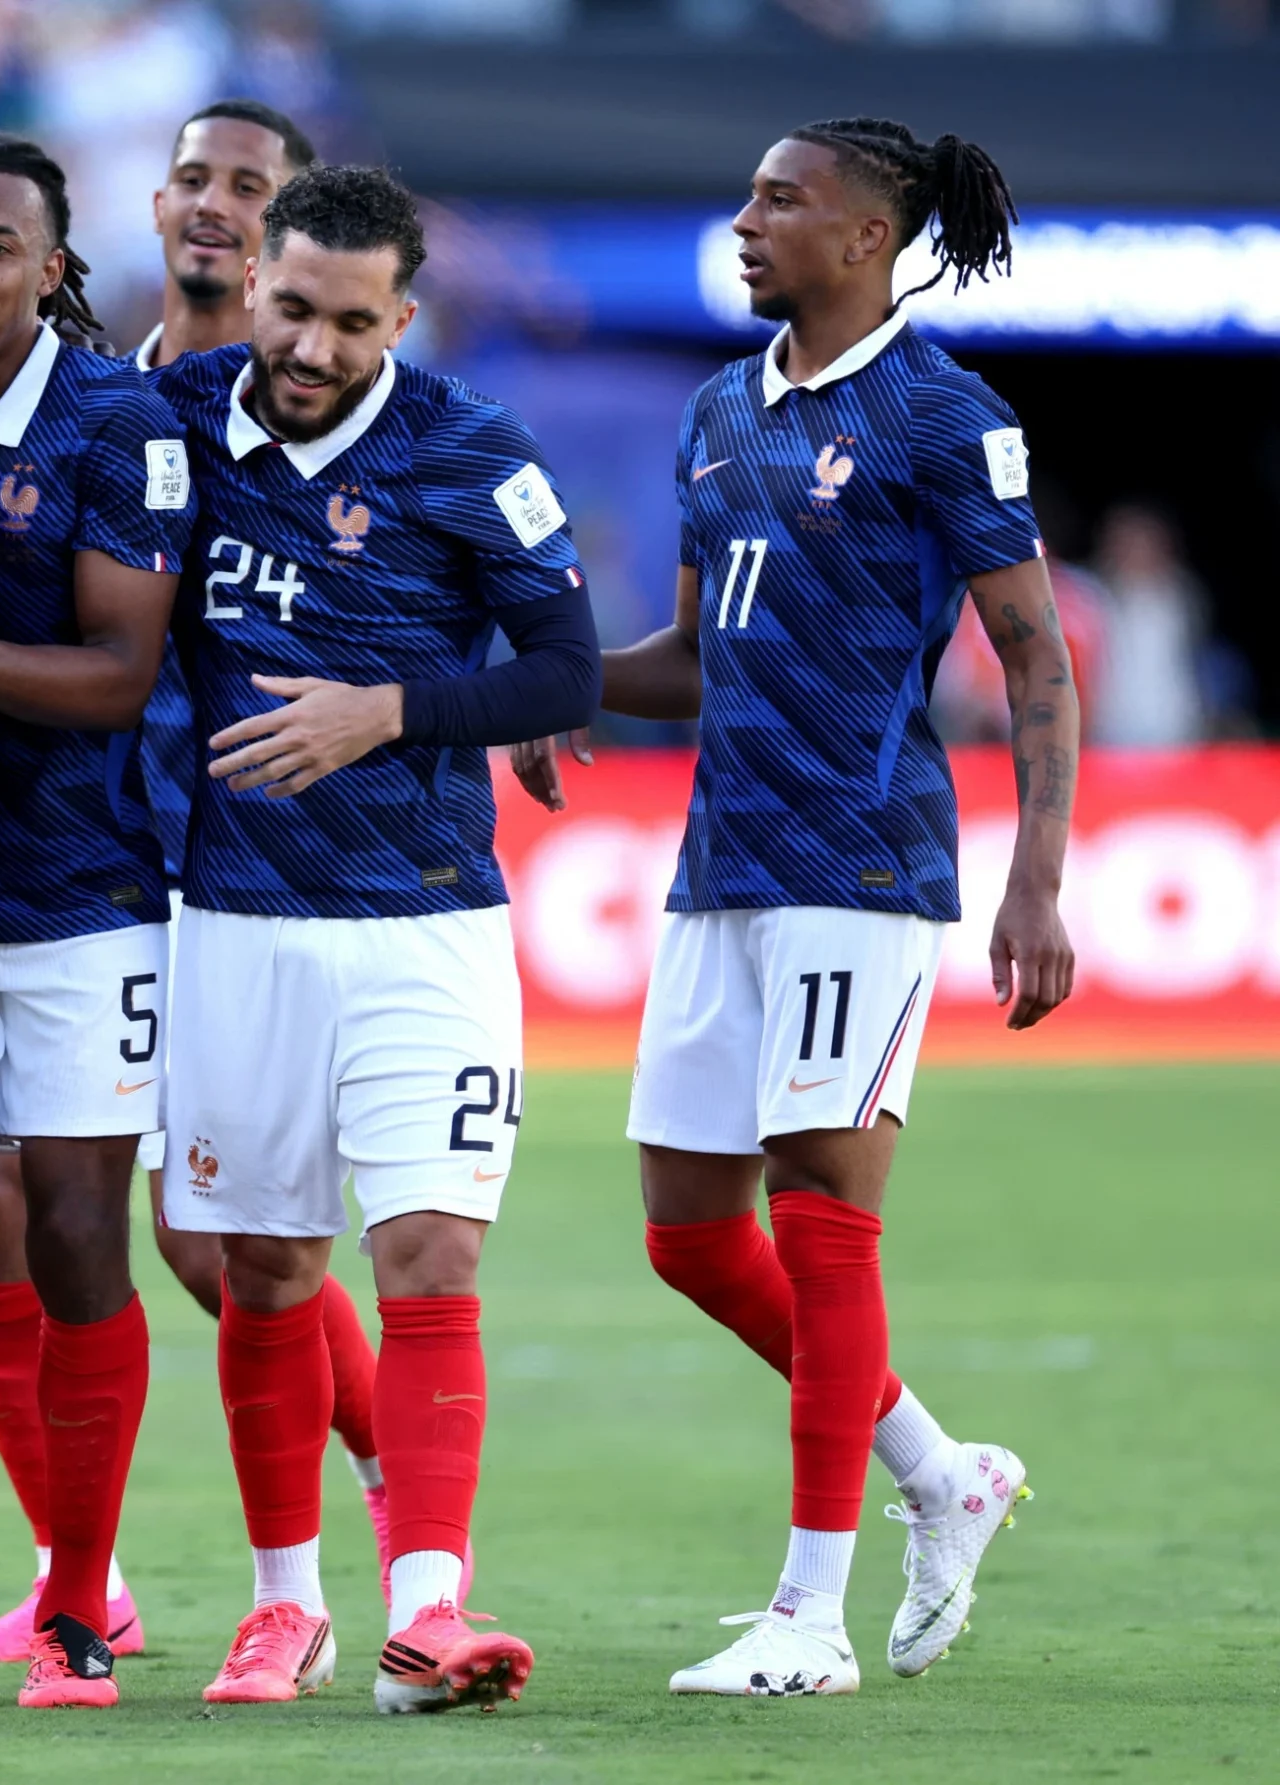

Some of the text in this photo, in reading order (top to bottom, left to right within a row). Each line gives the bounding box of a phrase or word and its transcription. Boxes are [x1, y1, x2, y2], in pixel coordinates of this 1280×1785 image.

[162, 482, 181, 495] PEACE
[204, 535, 305, 622] 24
[717, 539, 768, 629] 11
[120, 972, 157, 1063] 5
[799, 971, 853, 1060] 11
